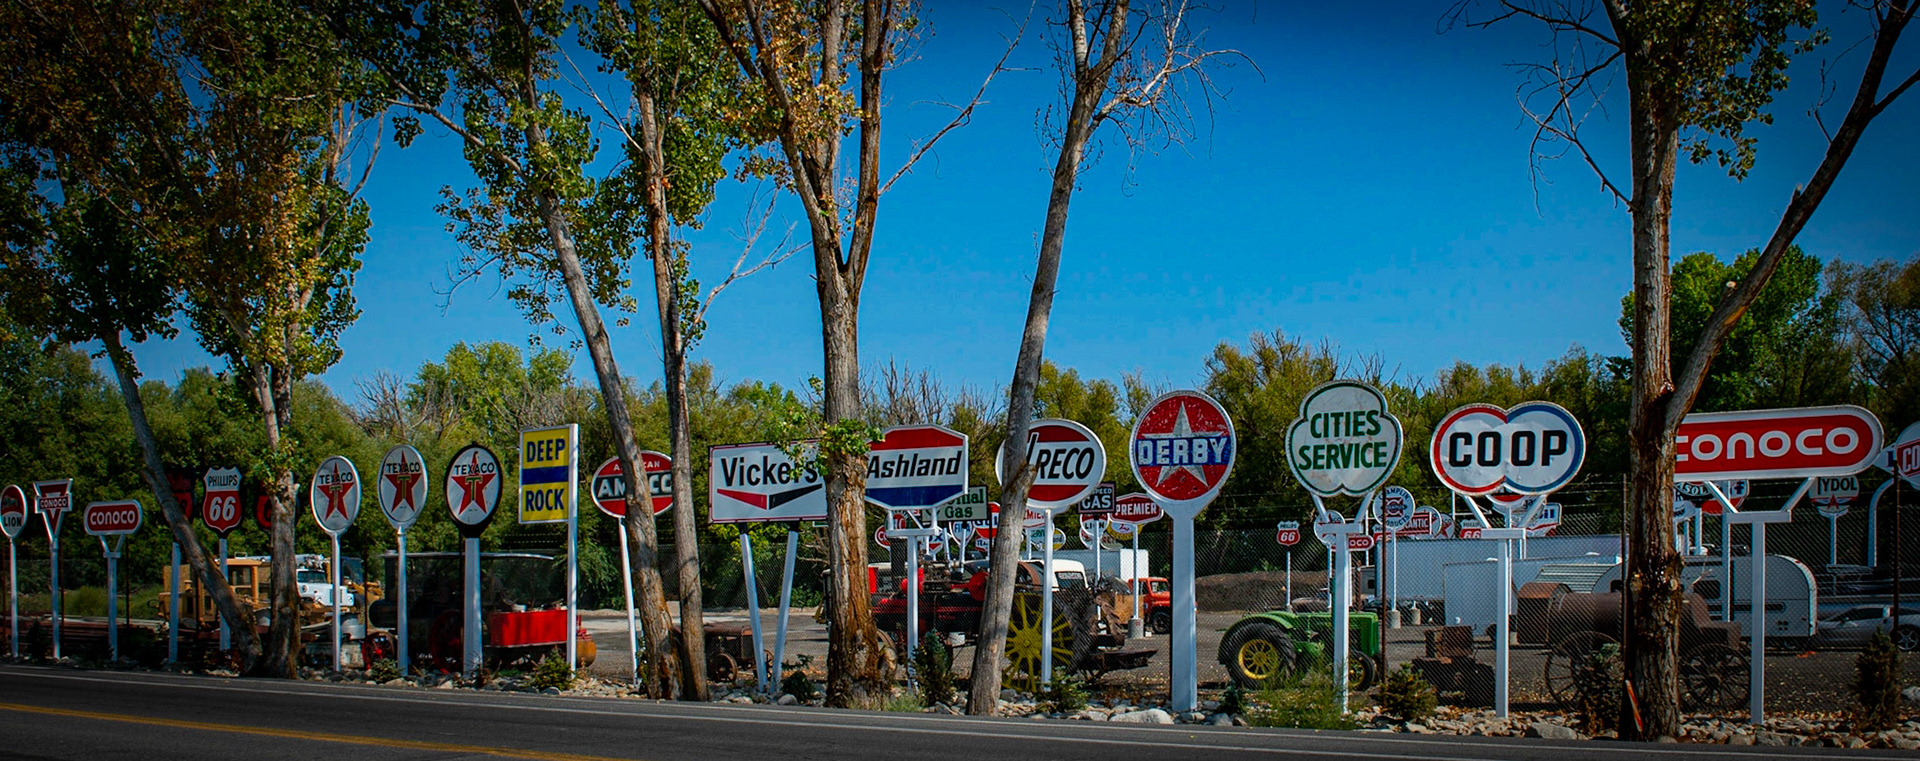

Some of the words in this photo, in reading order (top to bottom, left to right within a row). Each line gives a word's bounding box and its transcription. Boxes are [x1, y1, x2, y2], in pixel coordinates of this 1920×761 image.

[1310, 410, 1381, 438] CITIES
[526, 438, 566, 462] DEEP
[1138, 437, 1228, 466] DERBY
[1299, 441, 1388, 470] SERVICE
[386, 462, 420, 474] TEXACO
[454, 462, 495, 475] TEXACO
[866, 451, 962, 478] Ashland
[208, 474, 238, 487] PHILLIPS
[318, 472, 353, 484] TEXACO
[597, 473, 672, 498] AMCO
[525, 488, 565, 512] ROCK
[1378, 487, 1410, 500] CAMPLIN
[40, 498, 67, 508] CONOCO
[1082, 495, 1111, 509] GAS
[209, 496, 237, 522] 66
[944, 506, 973, 519] Gas
[1116, 503, 1156, 516] PREMIER
[1378, 514, 1410, 527] PODUCTS
[1280, 532, 1296, 542] 66
